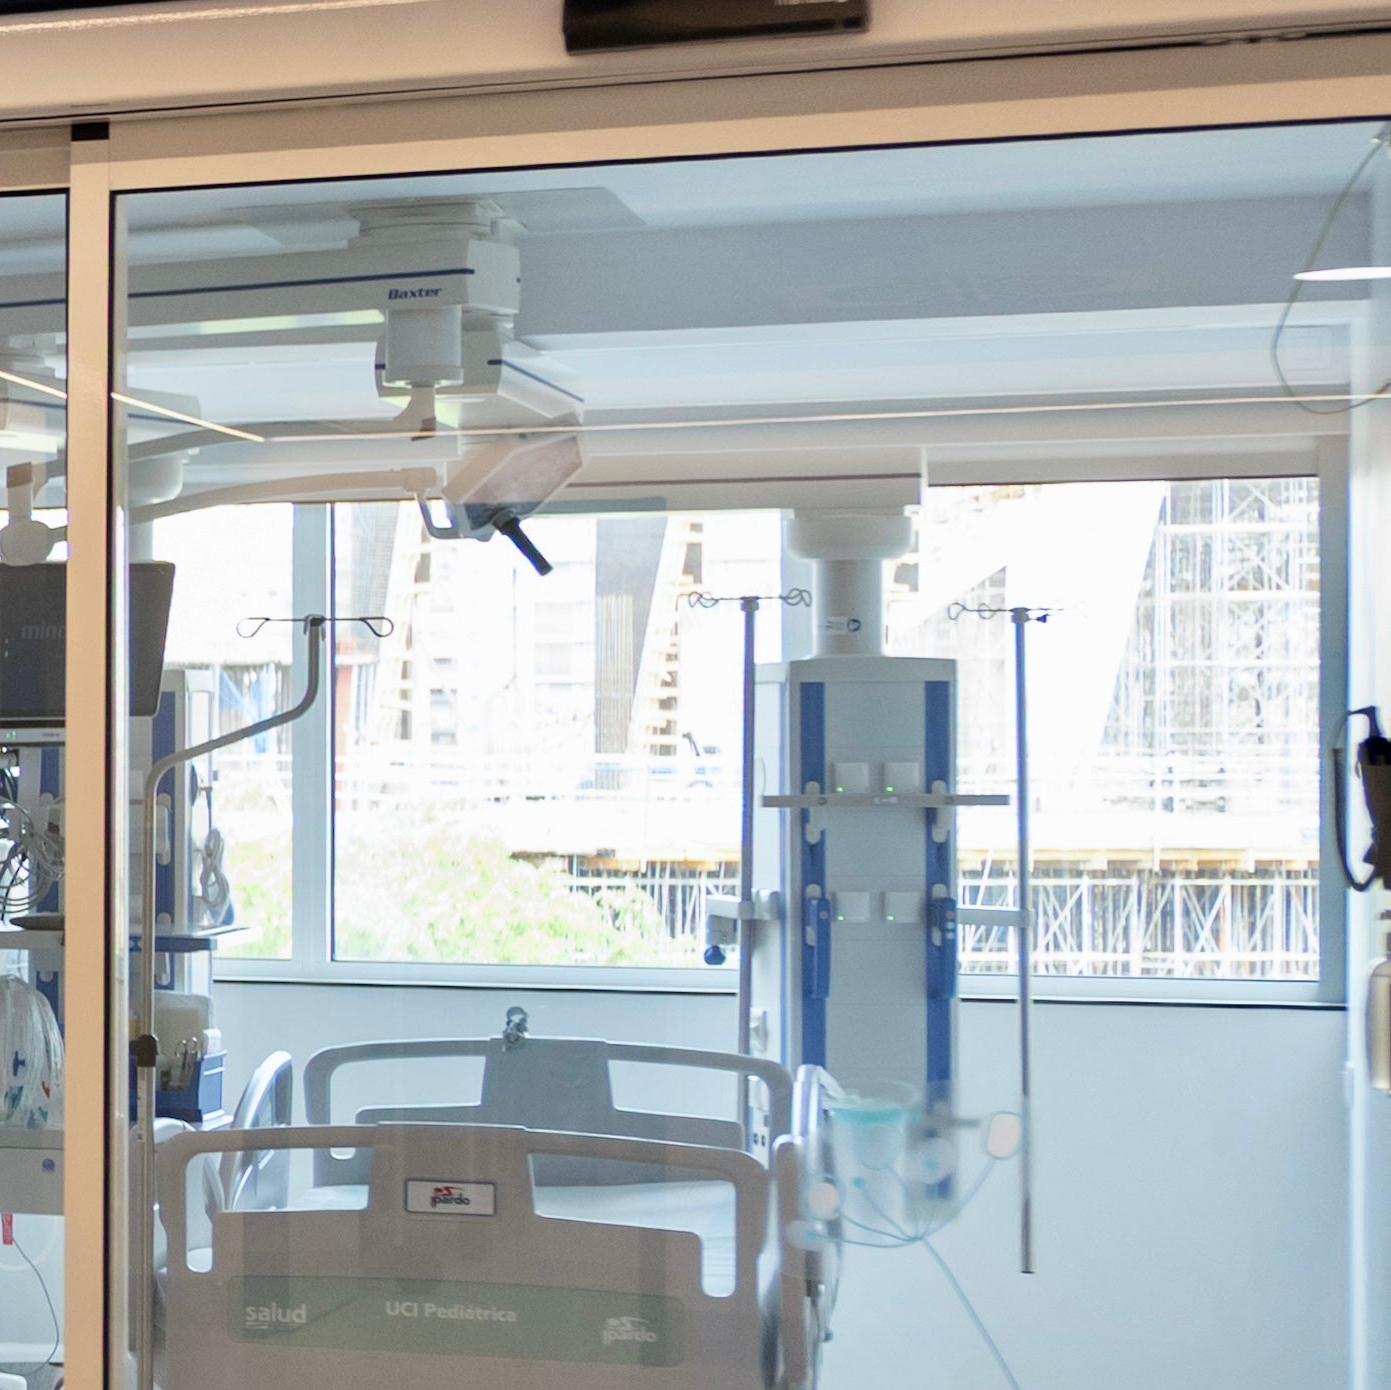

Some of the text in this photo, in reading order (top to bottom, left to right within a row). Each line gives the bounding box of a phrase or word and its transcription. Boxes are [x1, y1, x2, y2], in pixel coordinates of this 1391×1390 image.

[388, 287, 444, 300] Baxter
[245, 1302, 308, 1324] salud
[385, 1300, 518, 1323] UCI Pediátrica
